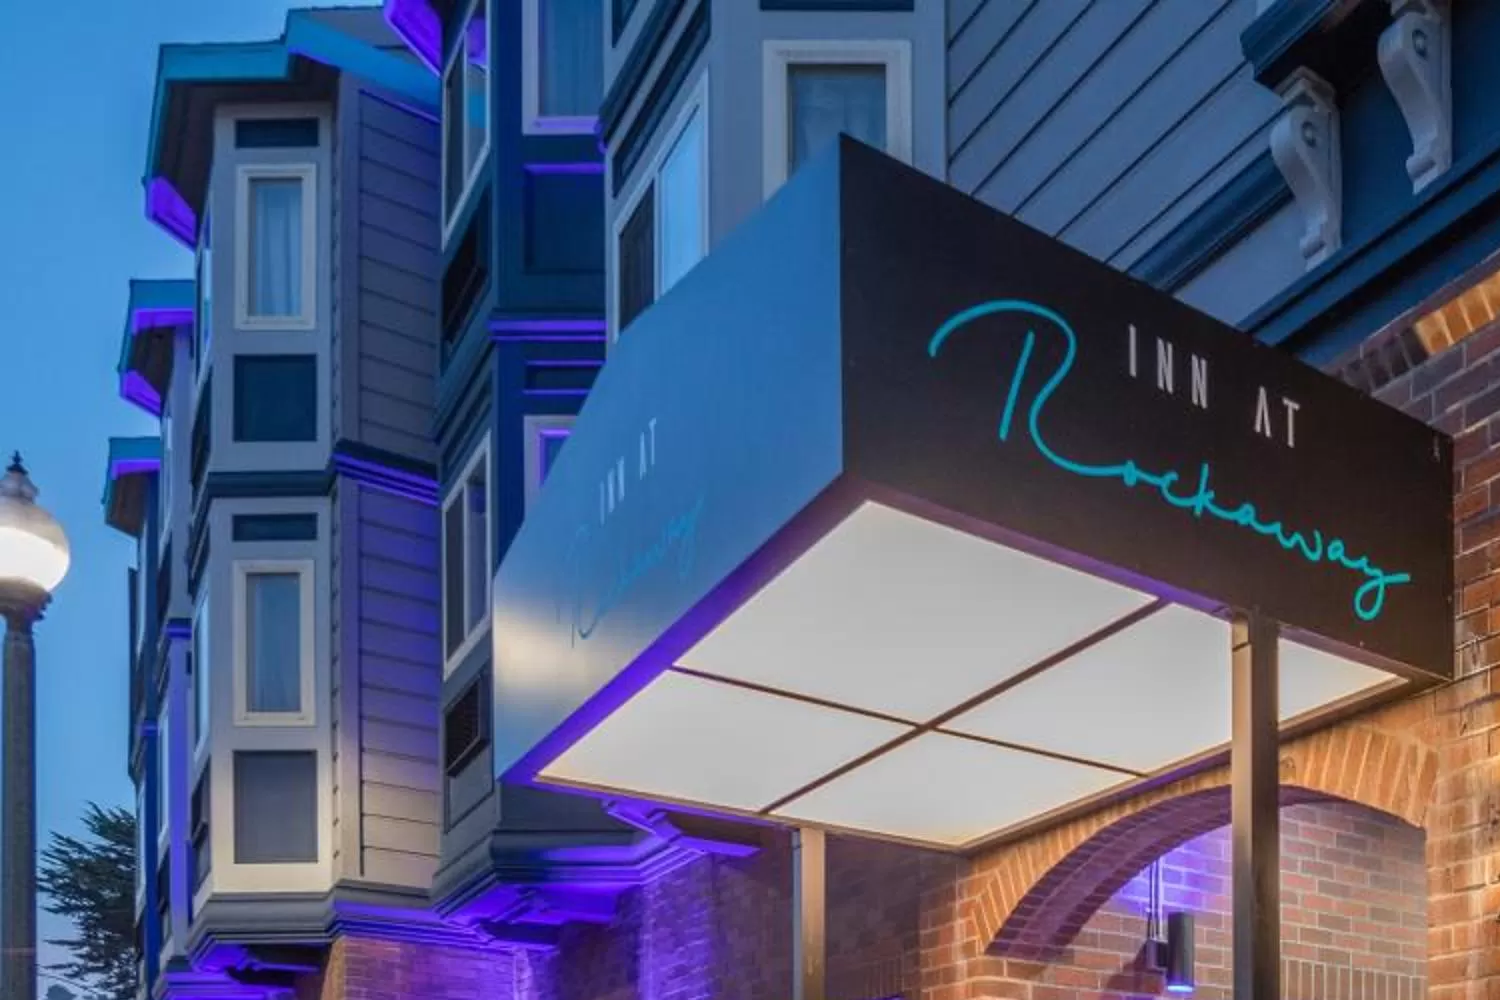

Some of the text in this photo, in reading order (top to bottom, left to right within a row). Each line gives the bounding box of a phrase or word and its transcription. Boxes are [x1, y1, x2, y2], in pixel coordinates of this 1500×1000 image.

[1128, 324, 1300, 448] INN AT
[639, 417, 657, 480] AT
[928, 299, 1411, 621] Rockaway
